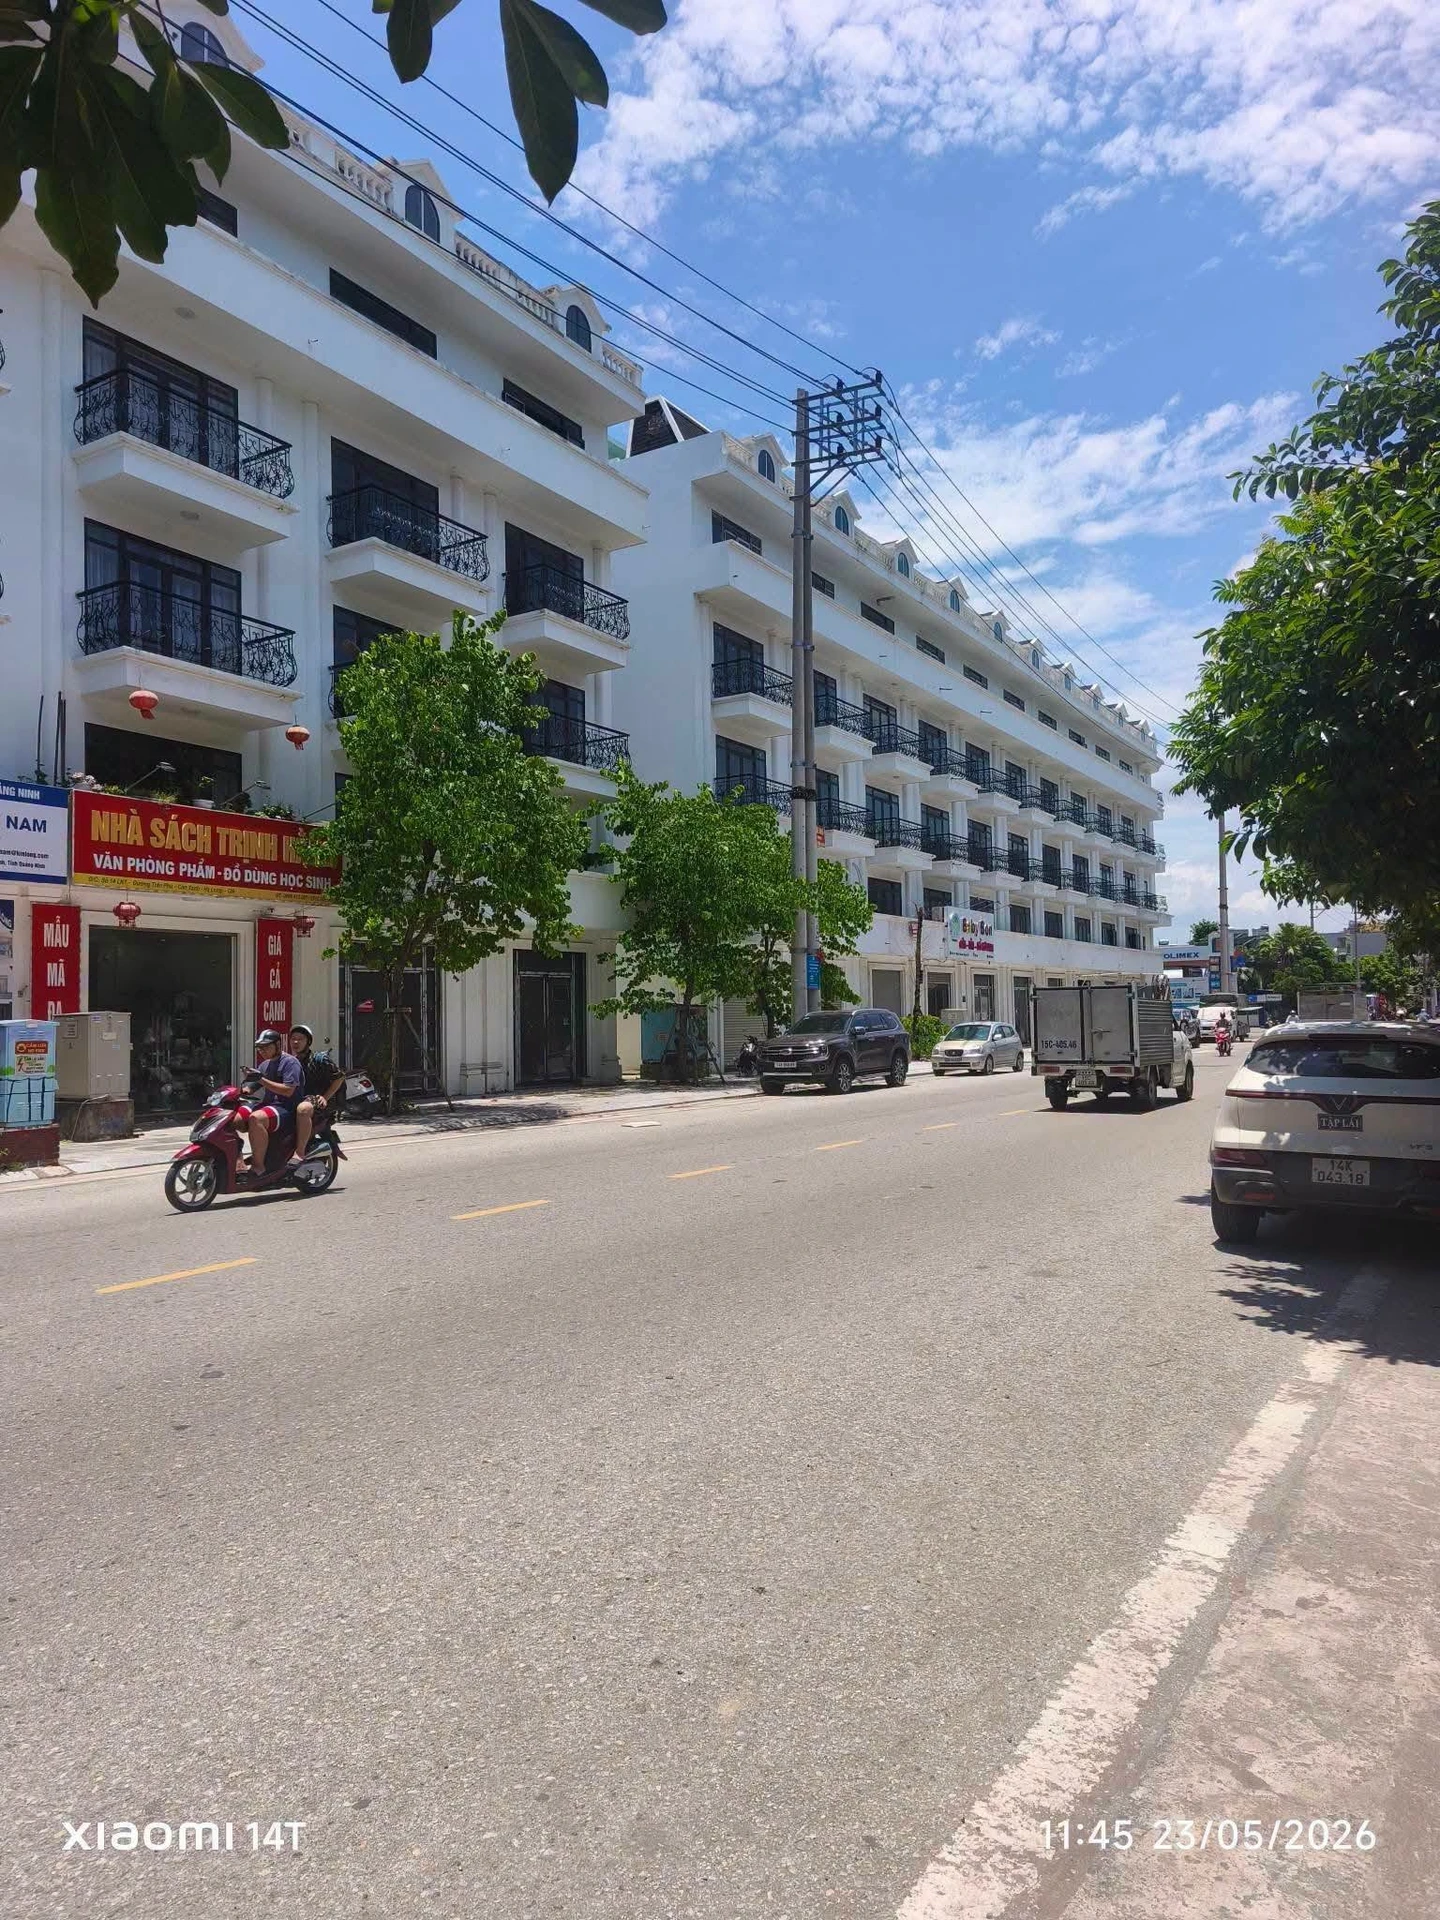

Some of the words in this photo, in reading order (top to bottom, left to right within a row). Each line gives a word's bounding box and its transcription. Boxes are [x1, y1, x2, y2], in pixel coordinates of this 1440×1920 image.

[18, 787, 40, 800] NINH
[6, 815, 47, 833] NAM
[91, 808, 144, 847] NHÀ
[149, 814, 212, 854] SÁCH
[216, 826, 278, 863] TRỊNH
[93, 851, 123, 871] VĂN
[127, 855, 175, 876] PHÒNG
[223, 862, 241, 882] ĐỒ
[244, 867, 277, 886] DÙNG
[280, 873, 304, 891] HỌC
[306, 876, 332, 891] SINH
[43, 916, 70, 948] MẪU
[268, 932, 282, 956] GIÁ
[47, 959, 66, 987] MÃ
[269, 962, 281, 988] CẢ
[263, 1001, 286, 1025] CẠNH
[1321, 1117, 1339, 1128] TẬP
[1342, 1117, 1359, 1128] LÁI
[1330, 1160, 1352, 1171] 14K
[1317, 1171, 1364, 1185] 043.18
